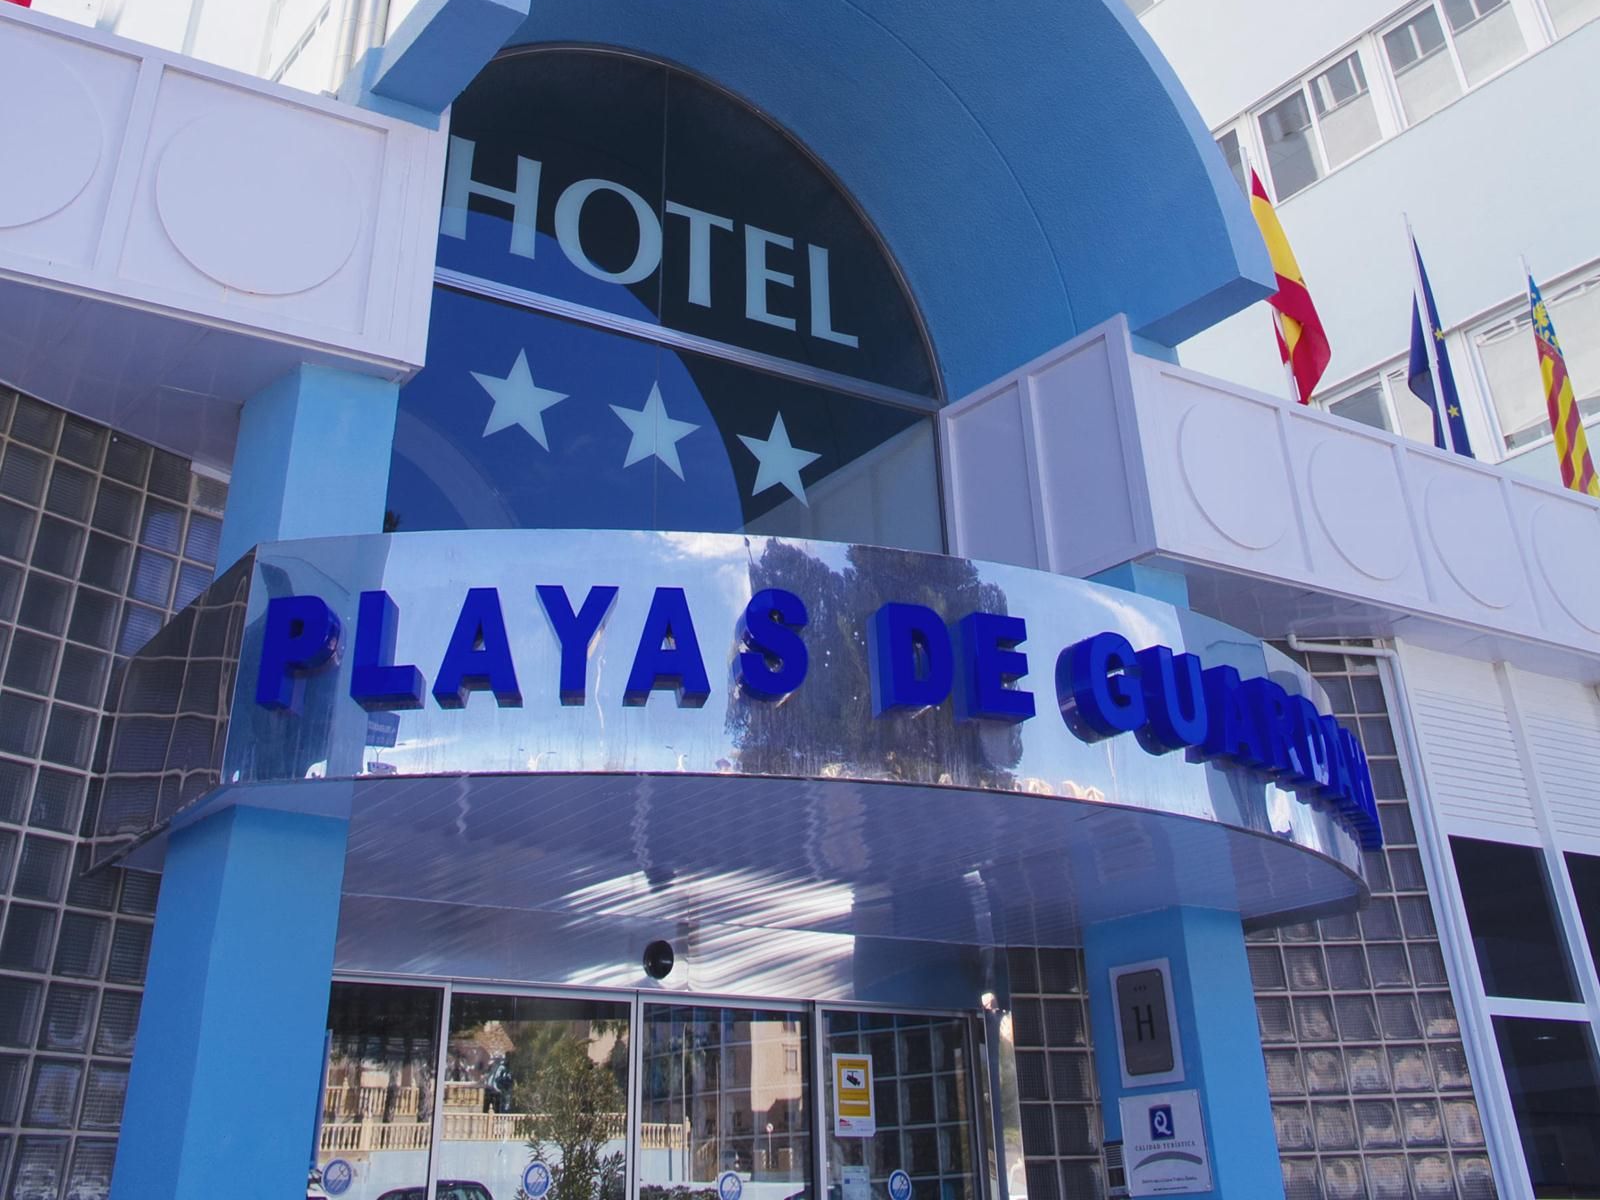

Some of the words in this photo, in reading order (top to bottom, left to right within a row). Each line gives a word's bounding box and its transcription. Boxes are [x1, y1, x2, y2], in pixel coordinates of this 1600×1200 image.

[440, 134, 859, 349] HOTEL
[256, 584, 809, 710] PLAYAS
[871, 602, 1036, 724] DE
[1131, 1004, 1156, 1043] H
[1154, 1110, 1172, 1135] Q
